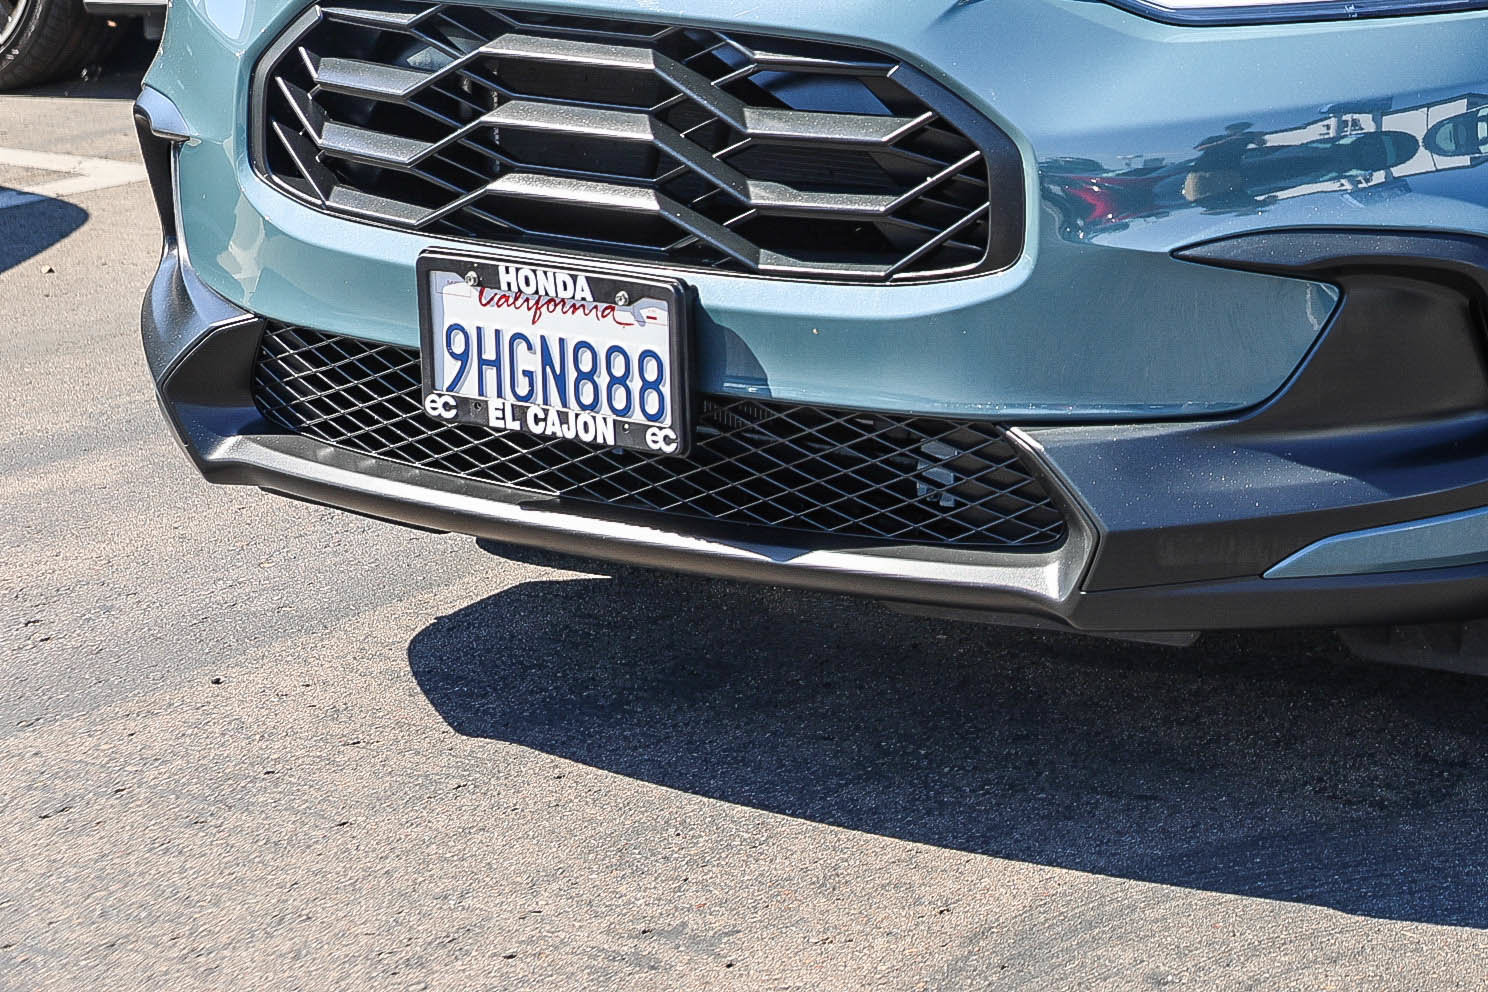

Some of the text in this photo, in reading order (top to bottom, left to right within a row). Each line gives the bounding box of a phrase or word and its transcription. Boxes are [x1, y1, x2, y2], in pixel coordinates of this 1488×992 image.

[498, 264, 594, 302] HONDA
[445, 322, 666, 424] 9HGN888
[488, 399, 616, 446] EL CAJON
